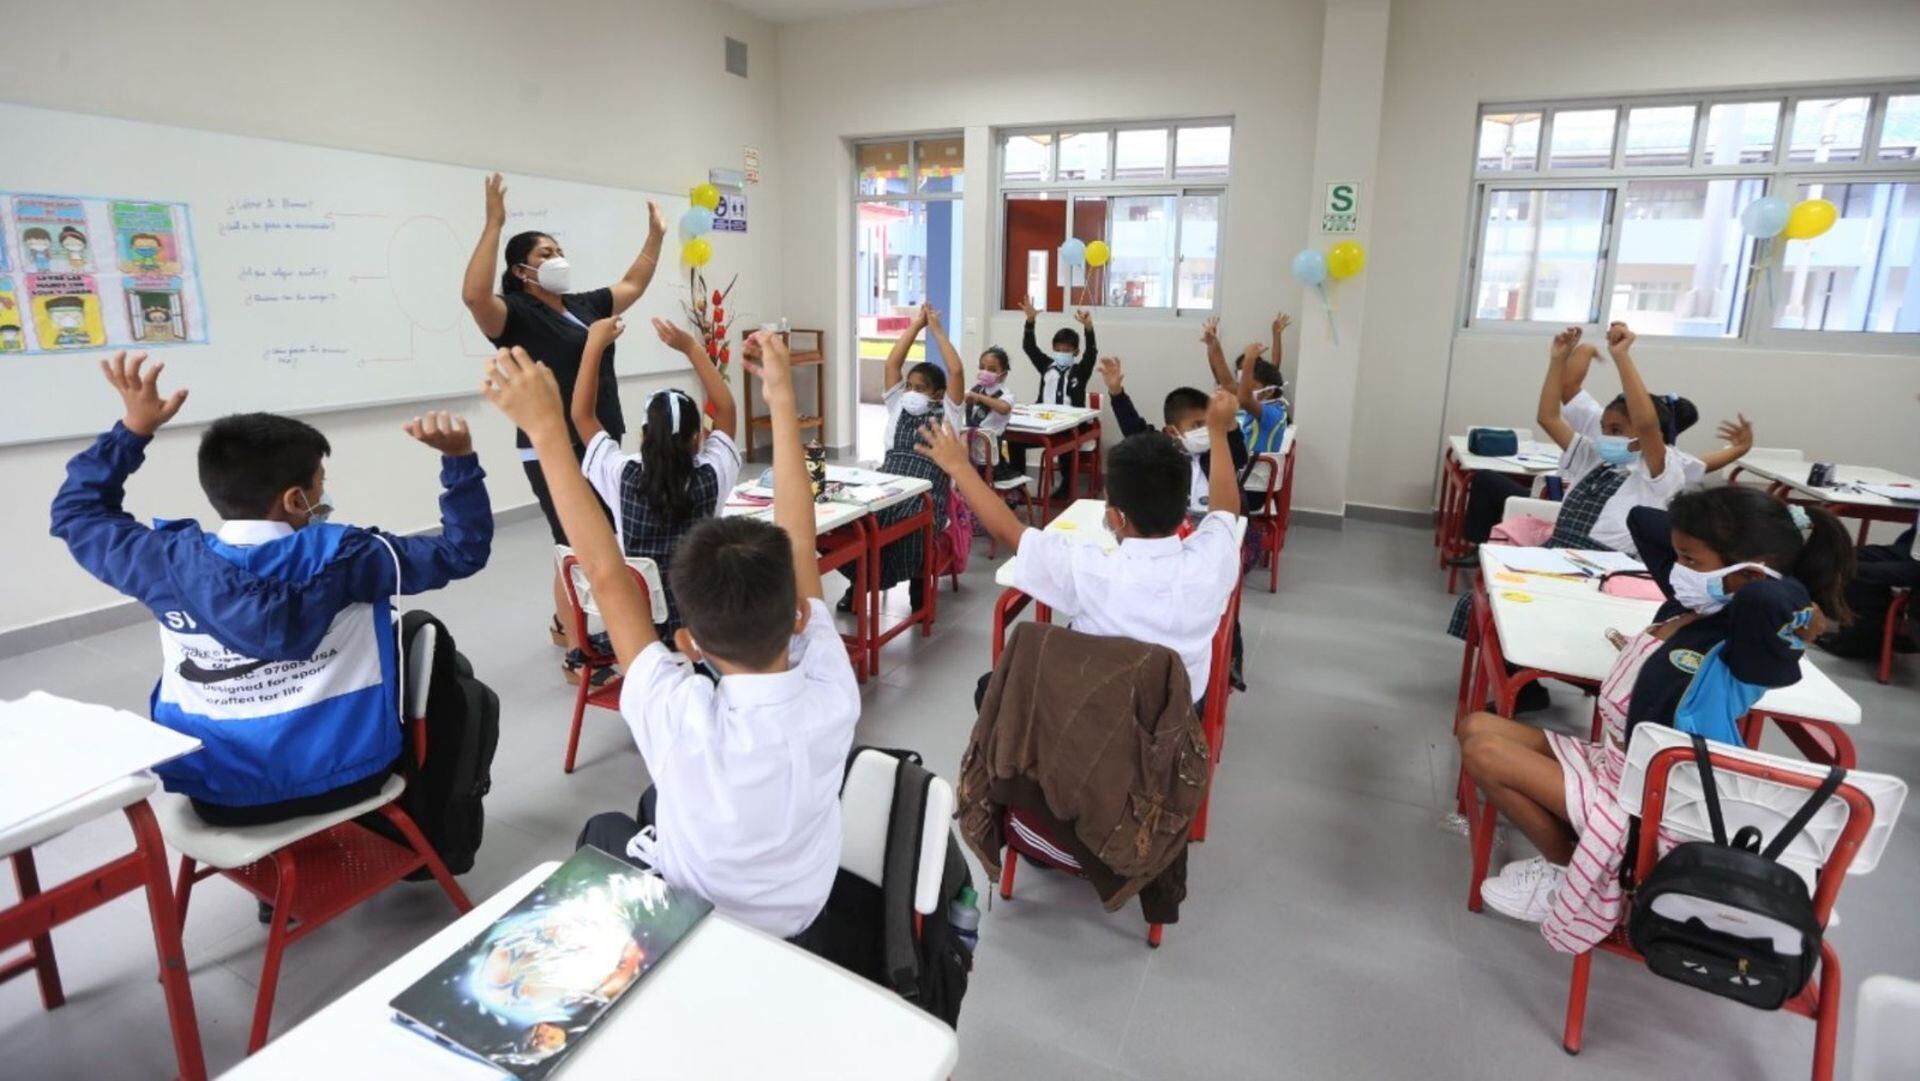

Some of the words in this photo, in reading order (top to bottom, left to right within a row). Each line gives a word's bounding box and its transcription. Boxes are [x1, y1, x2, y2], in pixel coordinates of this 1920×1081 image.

[1331, 185, 1353, 211] S
[309, 648, 339, 664] USA
[267, 677, 287, 688] for
[206, 693, 256, 706] crafted
[258, 692, 279, 703] for
[282, 684, 305, 698] life
